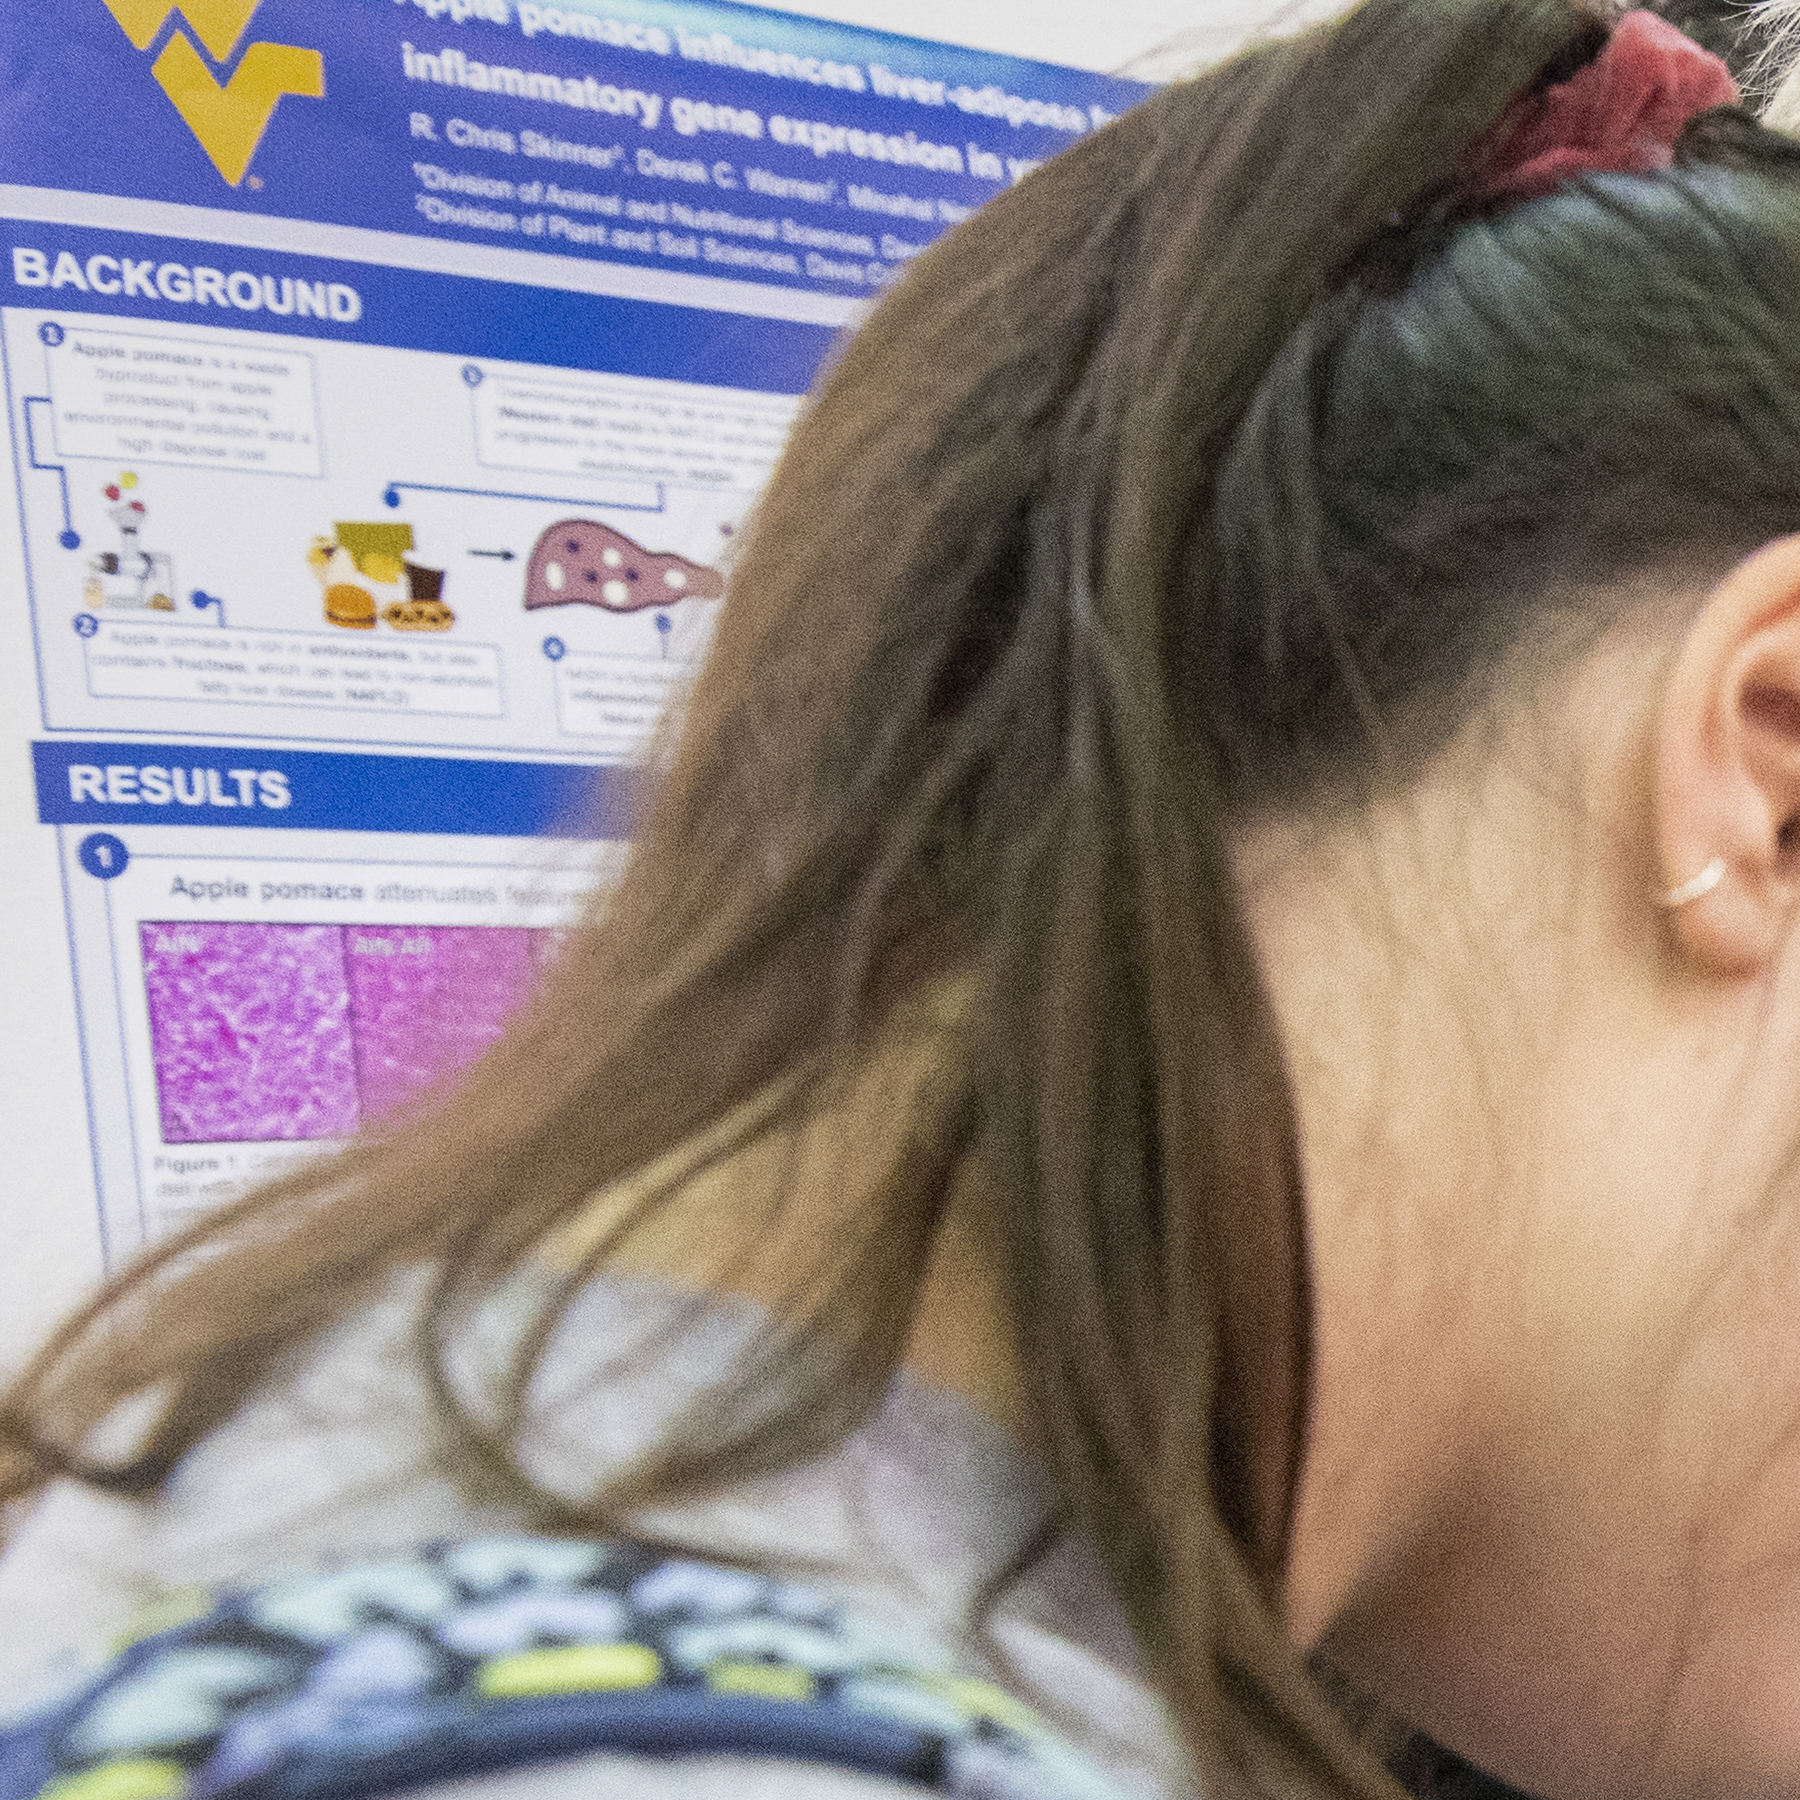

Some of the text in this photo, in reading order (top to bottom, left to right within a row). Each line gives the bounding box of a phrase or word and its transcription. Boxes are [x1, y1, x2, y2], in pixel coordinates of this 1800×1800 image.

[519, 3, 670, 56] pomace
[676, 26, 866, 93] influences
[400, 41, 663, 130] inflammatory
[669, 97, 764, 139] gene
[768, 115, 964, 174] expression
[13, 244, 361, 324] BACKGROUND
[67, 763, 292, 811] RESULTS
[169, 874, 250, 902] Apple
[261, 881, 364, 903] pomace
